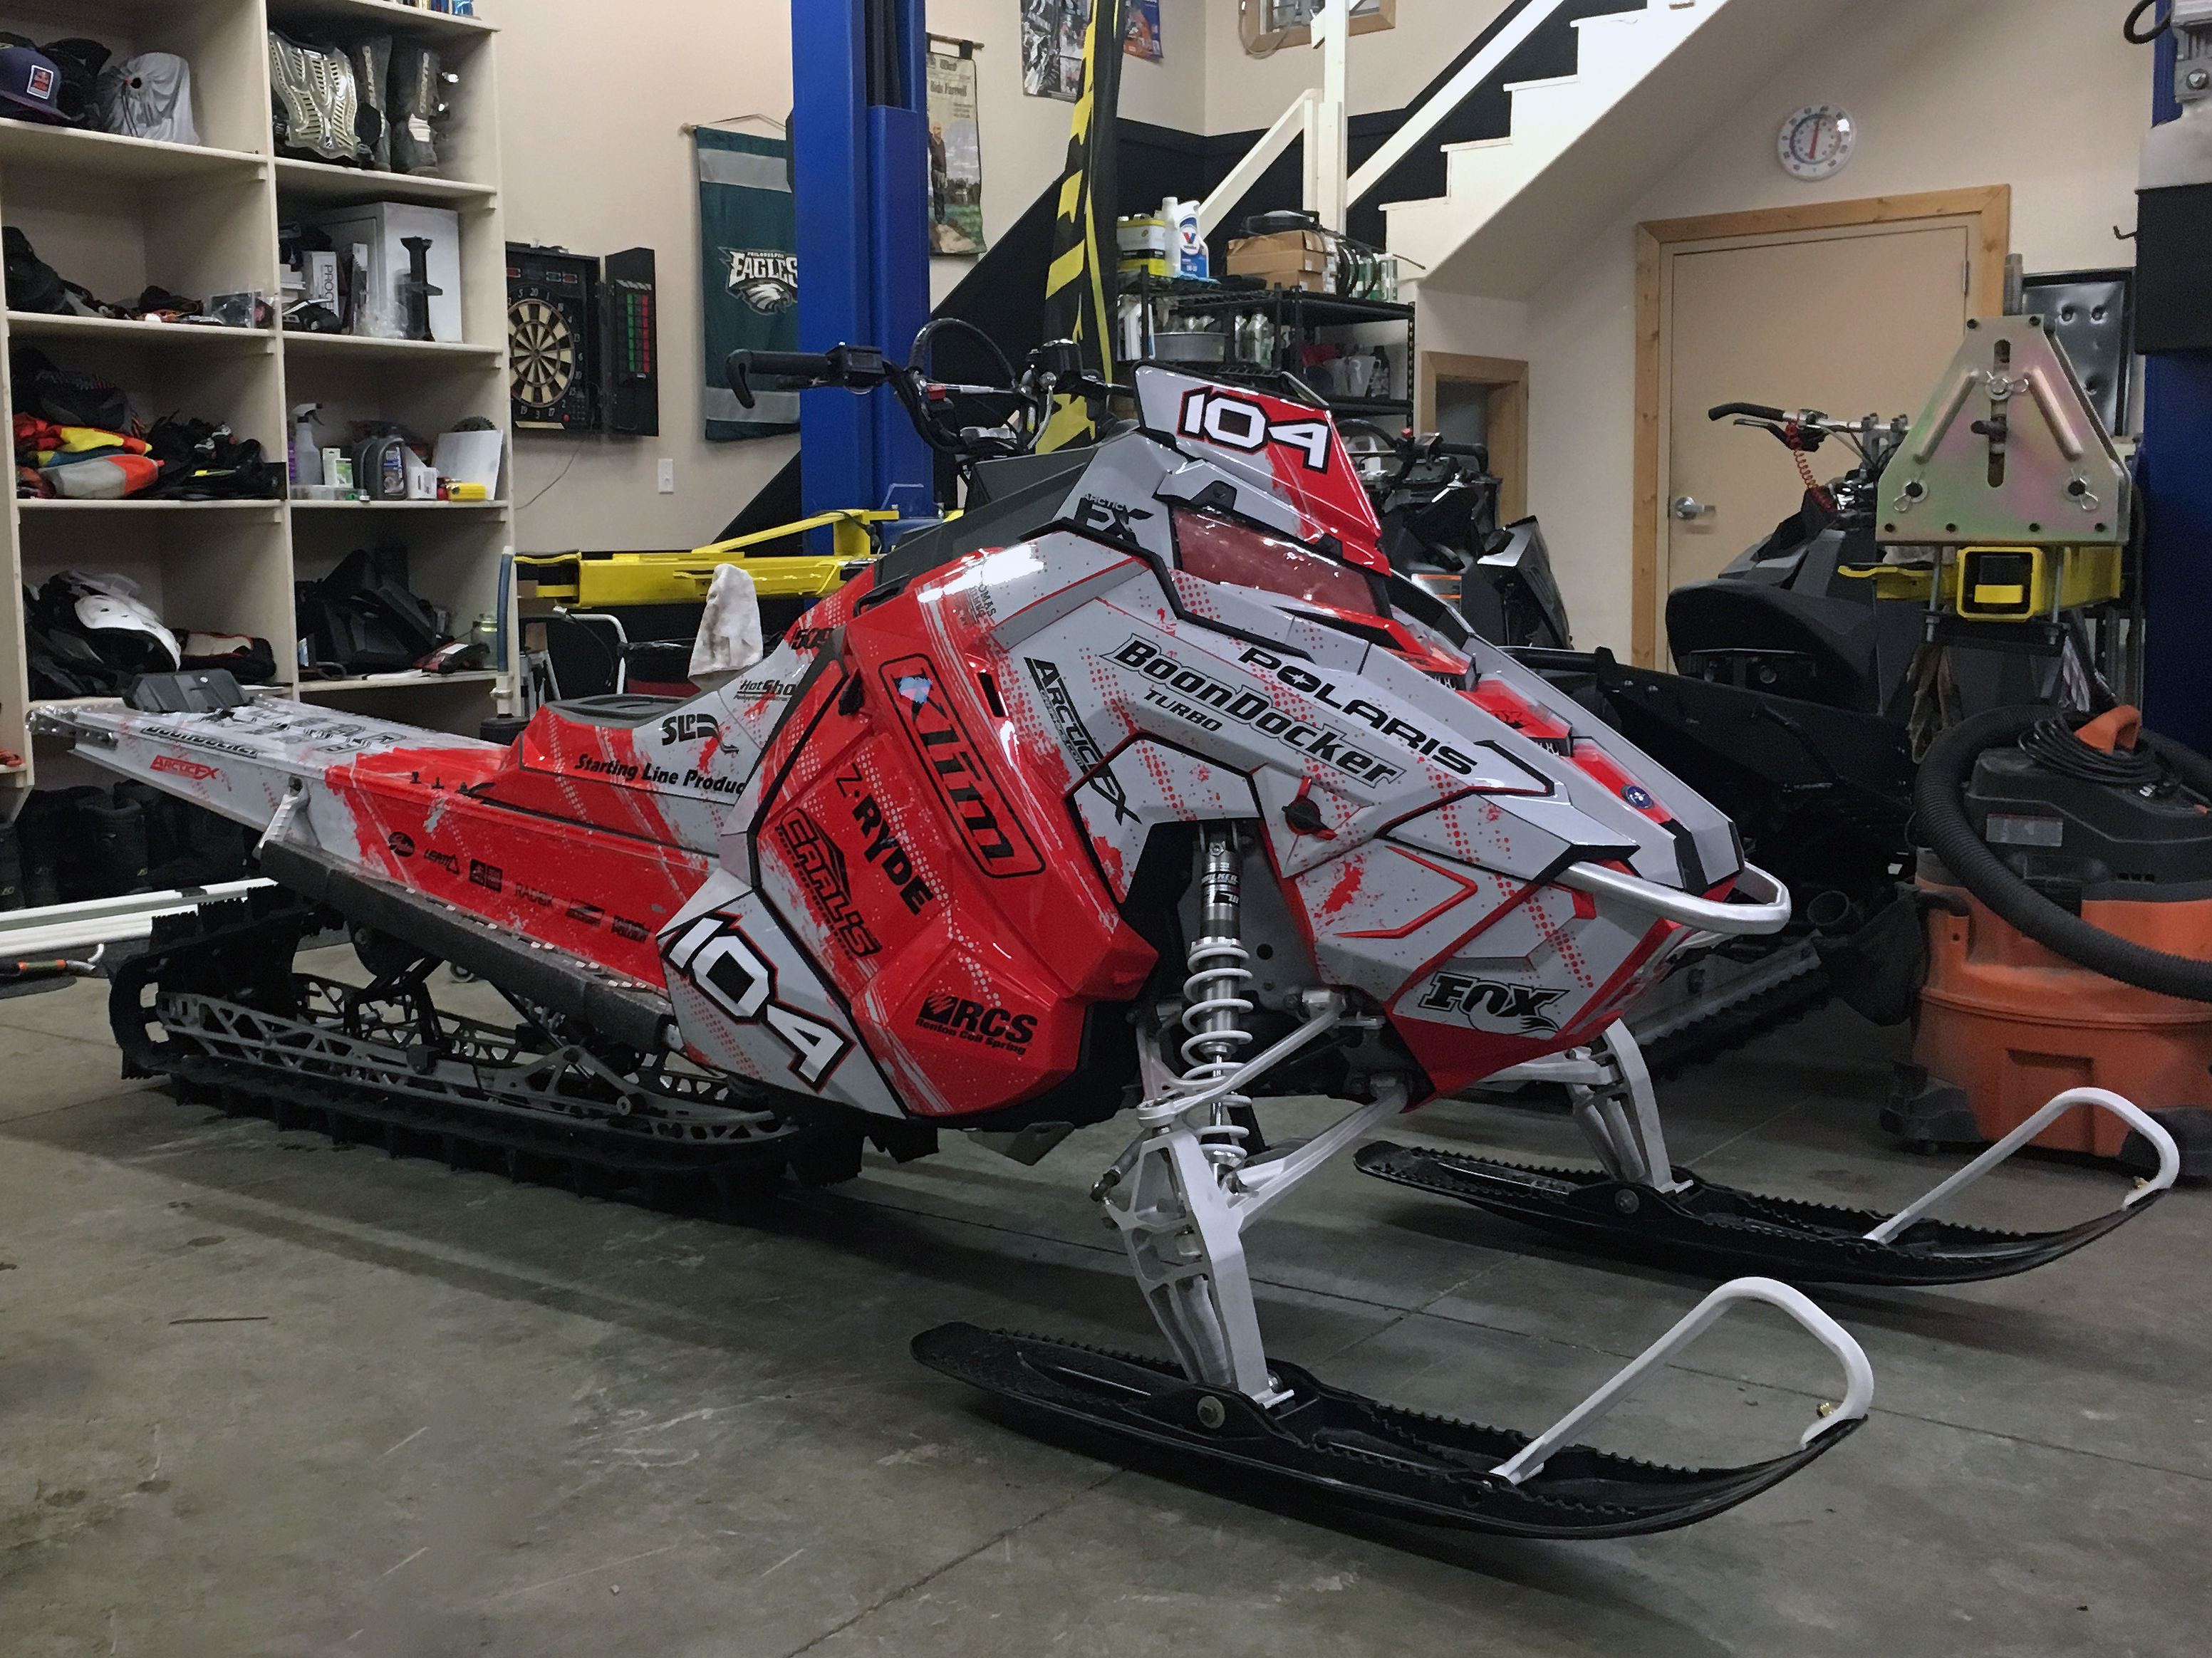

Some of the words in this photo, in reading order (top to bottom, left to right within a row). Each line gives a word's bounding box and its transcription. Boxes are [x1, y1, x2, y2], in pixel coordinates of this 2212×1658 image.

[729, 251, 798, 288] EAGLES
[1178, 386, 1333, 474] 104
[662, 714, 718, 746] SLP
[1110, 637, 1401, 786] BoonDocker
[1144, 690, 1222, 731] TURBO
[1238, 647, 1478, 776] POLARIS
[574, 755, 638, 781] Starting
[642, 763, 679, 783] Line
[682, 769, 749, 795] Produc
[662, 912, 856, 1090] 104
[1418, 971, 1570, 1018] FOX
[951, 999, 1038, 1043] RCS
[985, 1036, 1026, 1055] Spring
